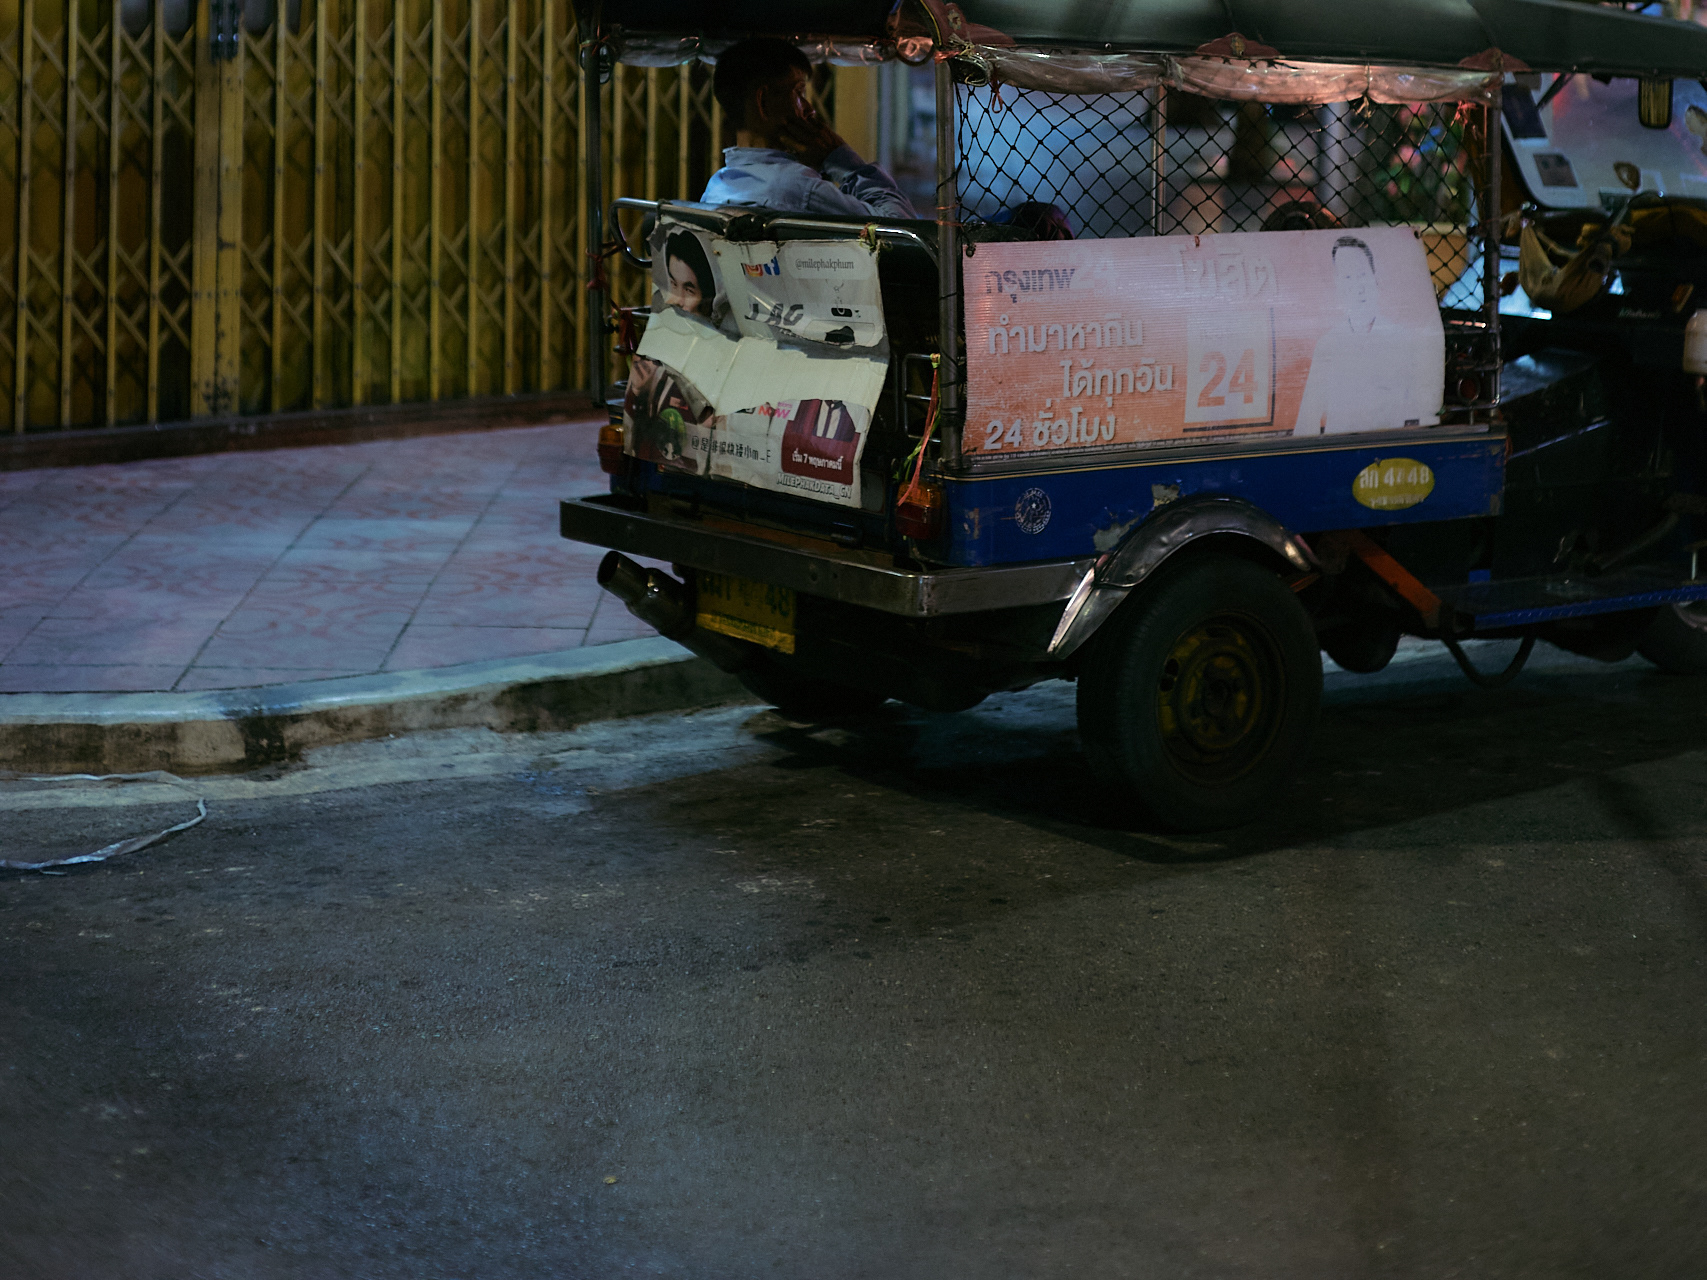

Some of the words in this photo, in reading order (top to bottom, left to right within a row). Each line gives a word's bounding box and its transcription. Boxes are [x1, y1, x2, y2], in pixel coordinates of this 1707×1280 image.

[989, 313, 1144, 354] ทำมาหากิน
[1060, 357, 1174, 408] ได้ทุกวัน
[1197, 348, 1259, 408] 24
[983, 418, 1023, 450] 24
[1032, 398, 1116, 447] ชั่วโมง
[803, 453, 808, 464] 7
